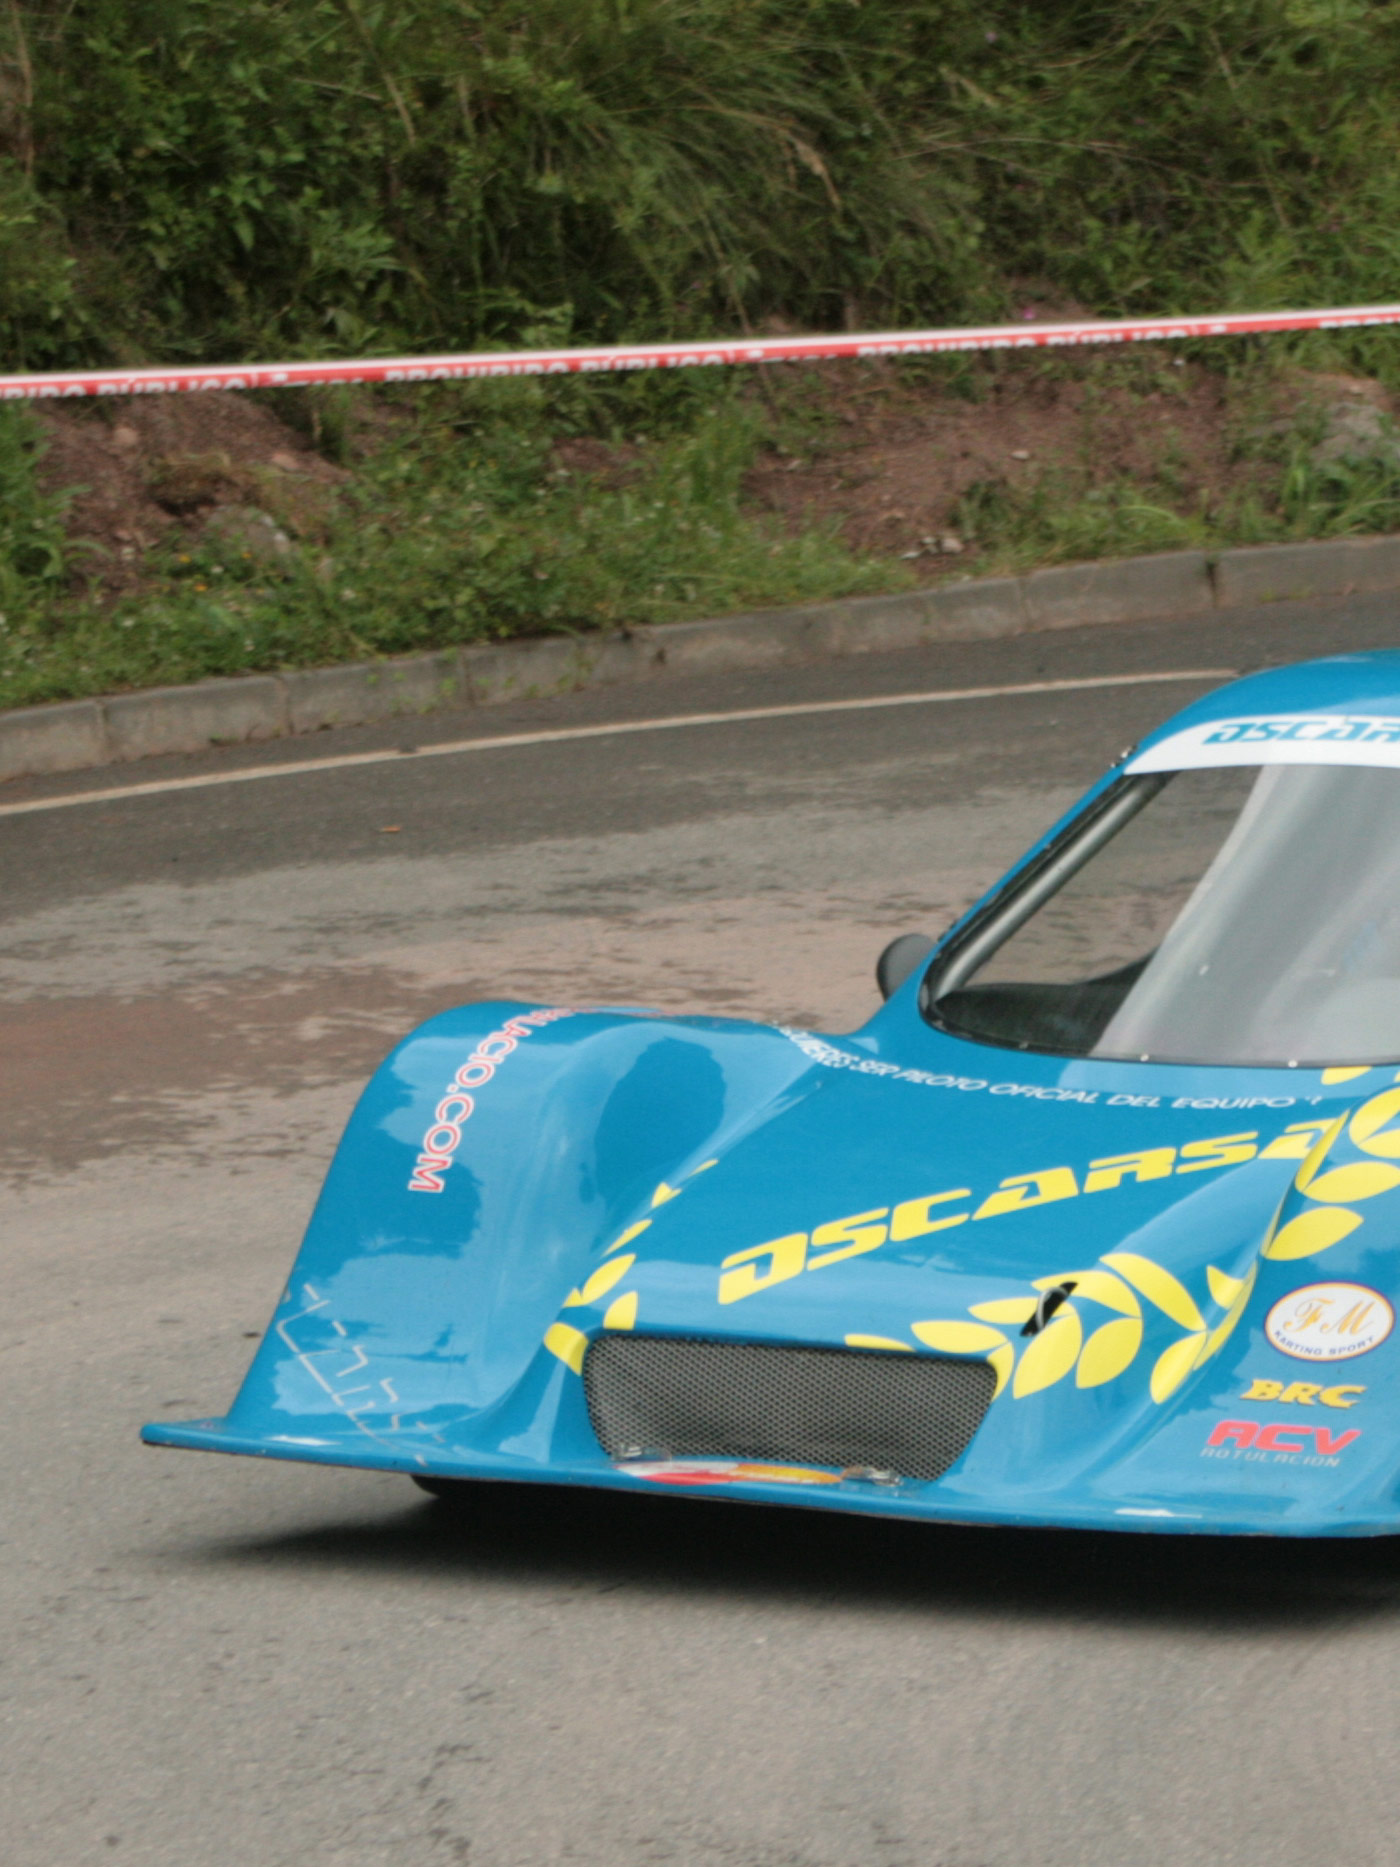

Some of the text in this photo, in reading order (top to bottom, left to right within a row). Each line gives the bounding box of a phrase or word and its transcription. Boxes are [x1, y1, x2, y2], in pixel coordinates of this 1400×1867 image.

[988, 1083, 1102, 1104] OFICIAL
[1105, 1093, 1161, 1108] DEL
[1170, 1096, 1297, 1109] EQUIPO
[1274, 1330, 1376, 1356] KARTING SPORT
[1240, 1379, 1367, 1408] BRC
[1206, 1419, 1363, 1456] ACV
